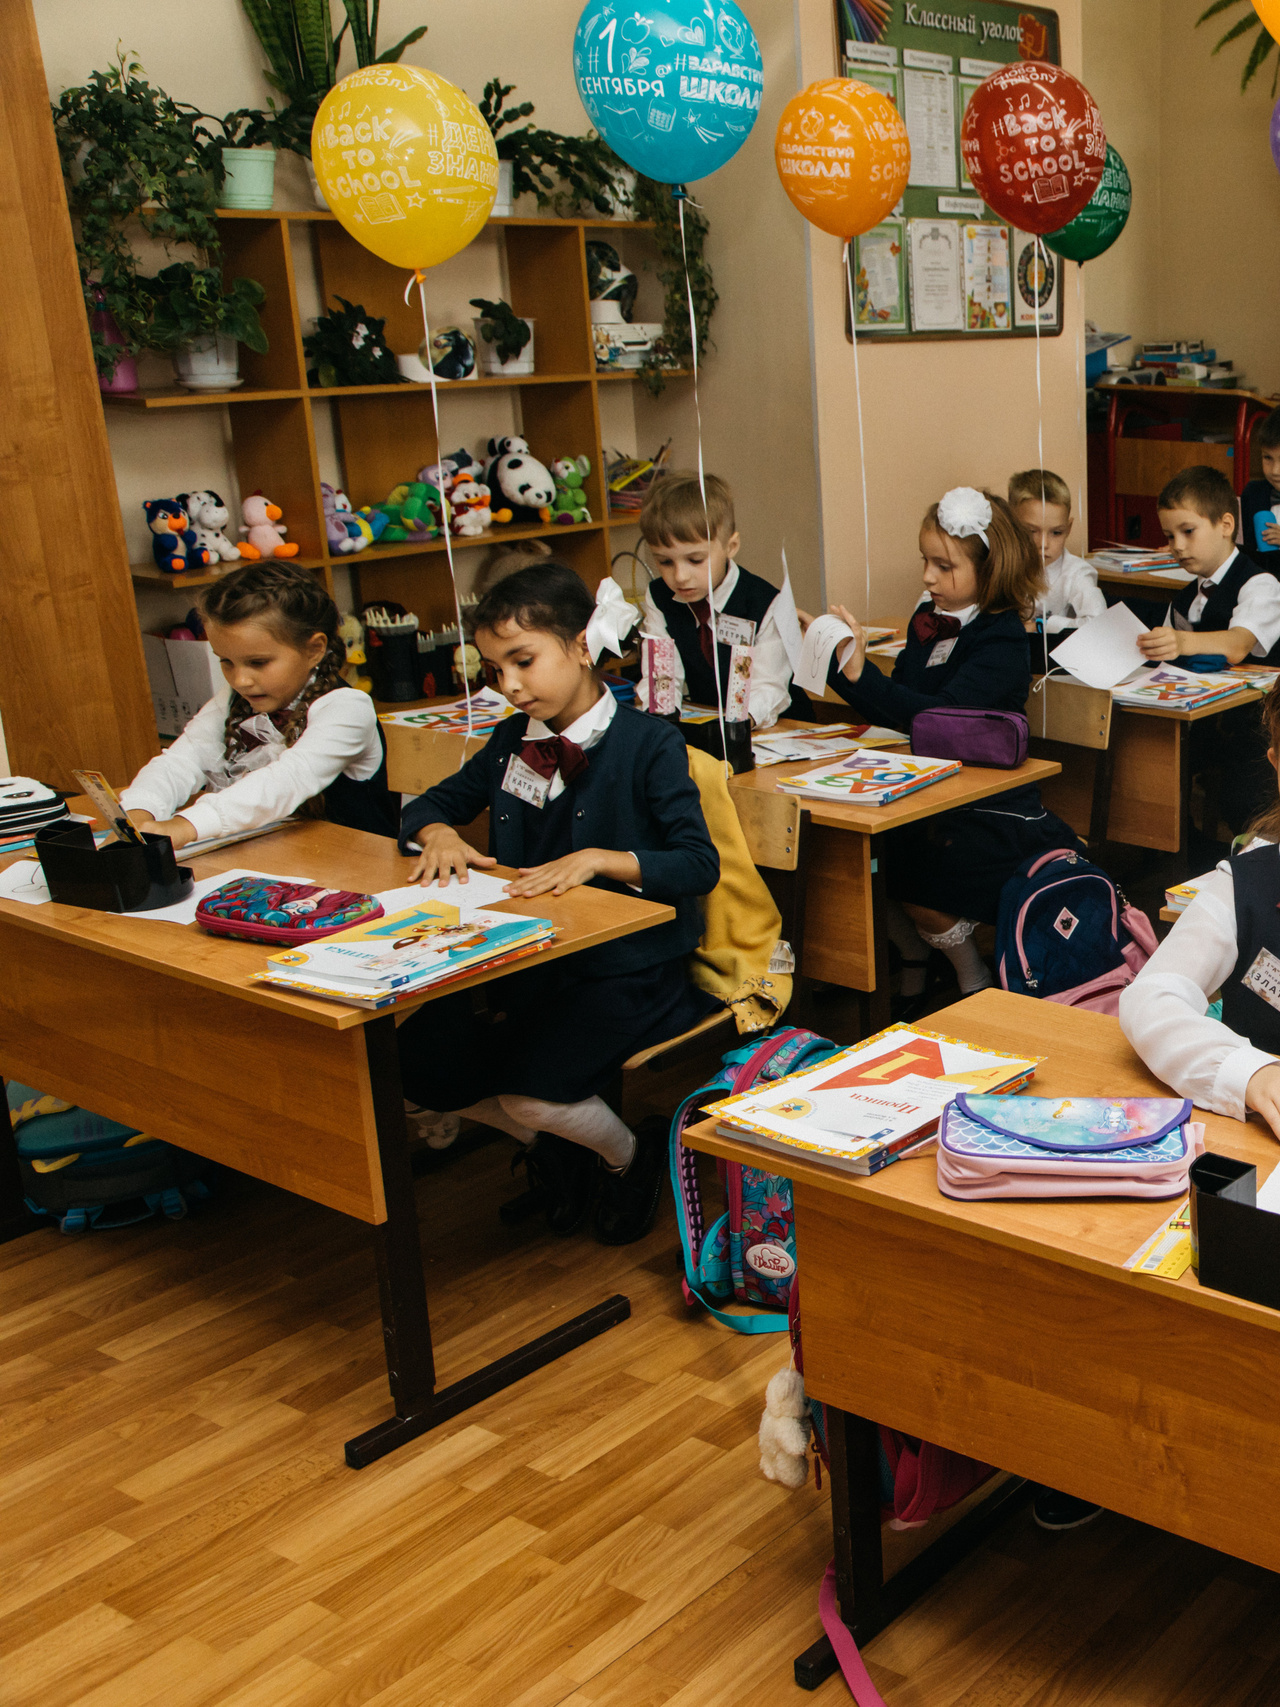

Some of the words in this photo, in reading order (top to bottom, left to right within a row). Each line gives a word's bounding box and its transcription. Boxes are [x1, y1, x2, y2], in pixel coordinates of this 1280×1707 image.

[905, 2, 976, 35] Классный
[980, 20, 1023, 45] уголок
[580, 76, 665, 98] СЕНТЯБРЯ
[850, 1092, 921, 1114] Прописи
